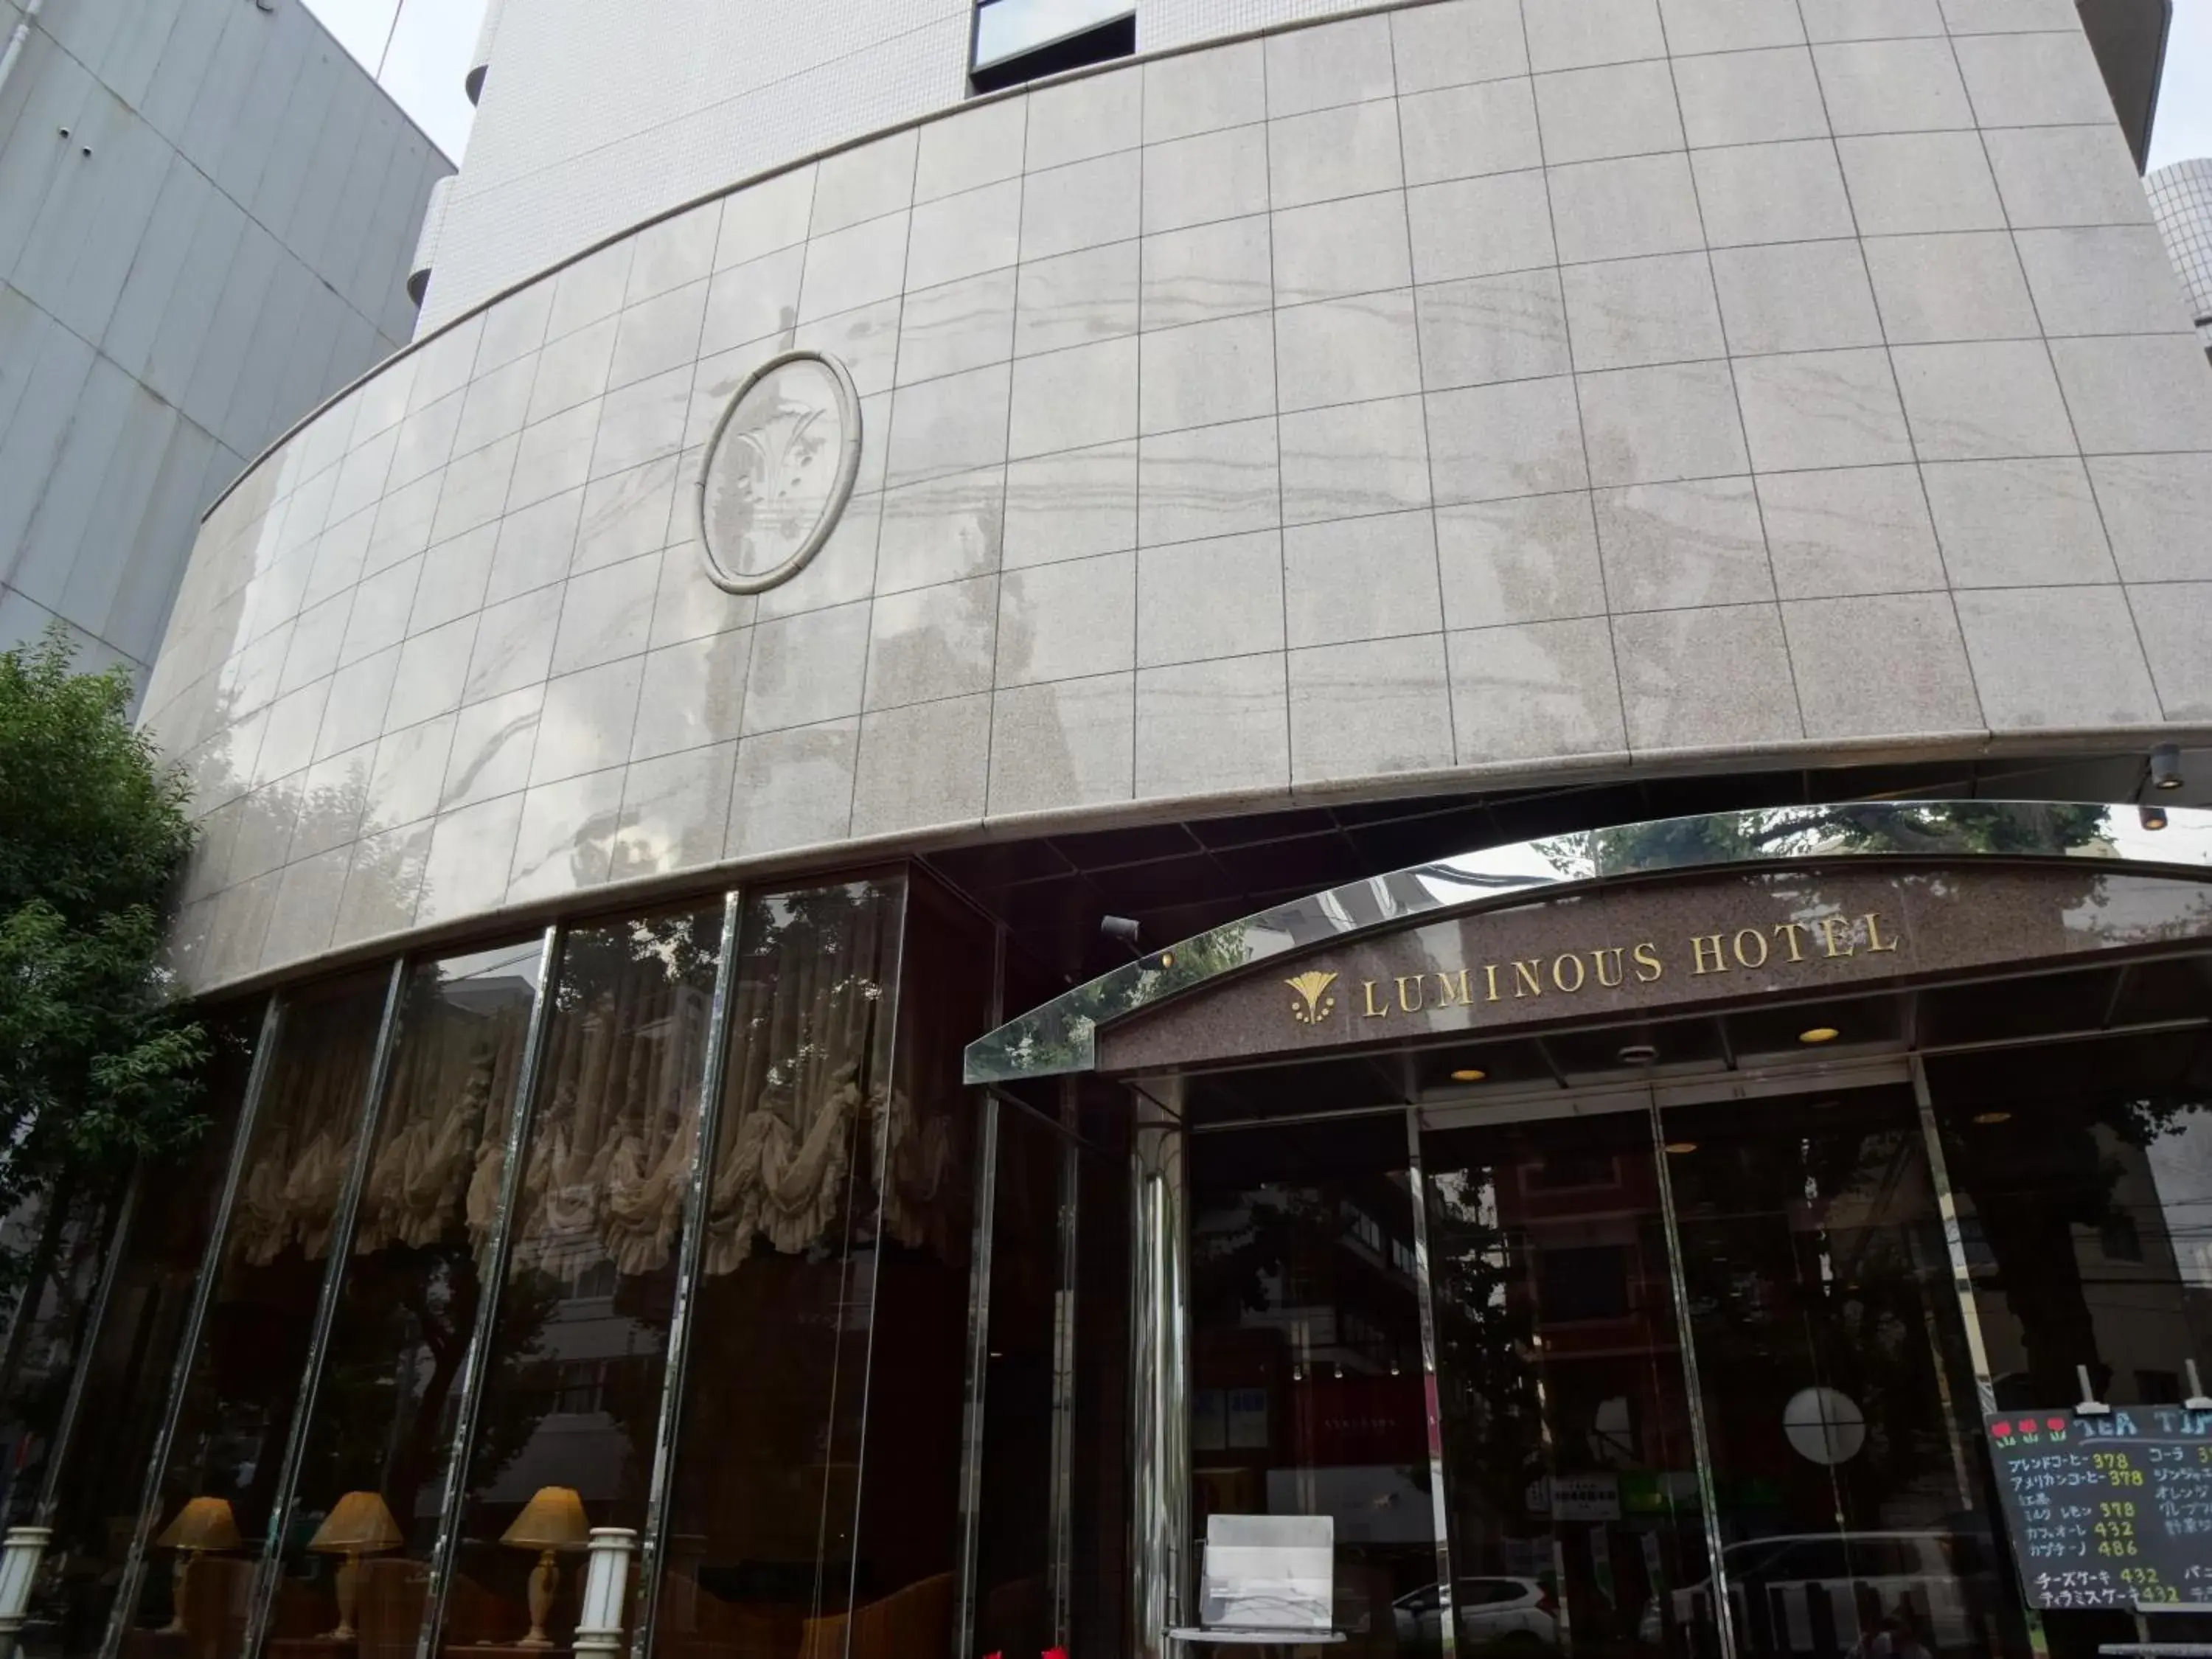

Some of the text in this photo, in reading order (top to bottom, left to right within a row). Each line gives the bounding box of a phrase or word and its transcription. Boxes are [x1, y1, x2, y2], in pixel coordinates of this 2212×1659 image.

[1362, 913, 1899, 1018] LUMINOUS HOTEL
[2074, 1411, 2138, 1437] TEA
[2093, 1453, 2129, 1470] 378
[2149, 1446, 2183, 1463] コーラ
[2110, 1471, 2143, 1486] 378
[2099, 1502, 2135, 1518] 378
[2094, 1522, 2134, 1537] 432
[2098, 1540, 2138, 1557] 486
[2034, 1568, 2160, 1590] チーズケーキ 432
[2039, 1586, 2180, 1607] ティラミスケーキ 432
